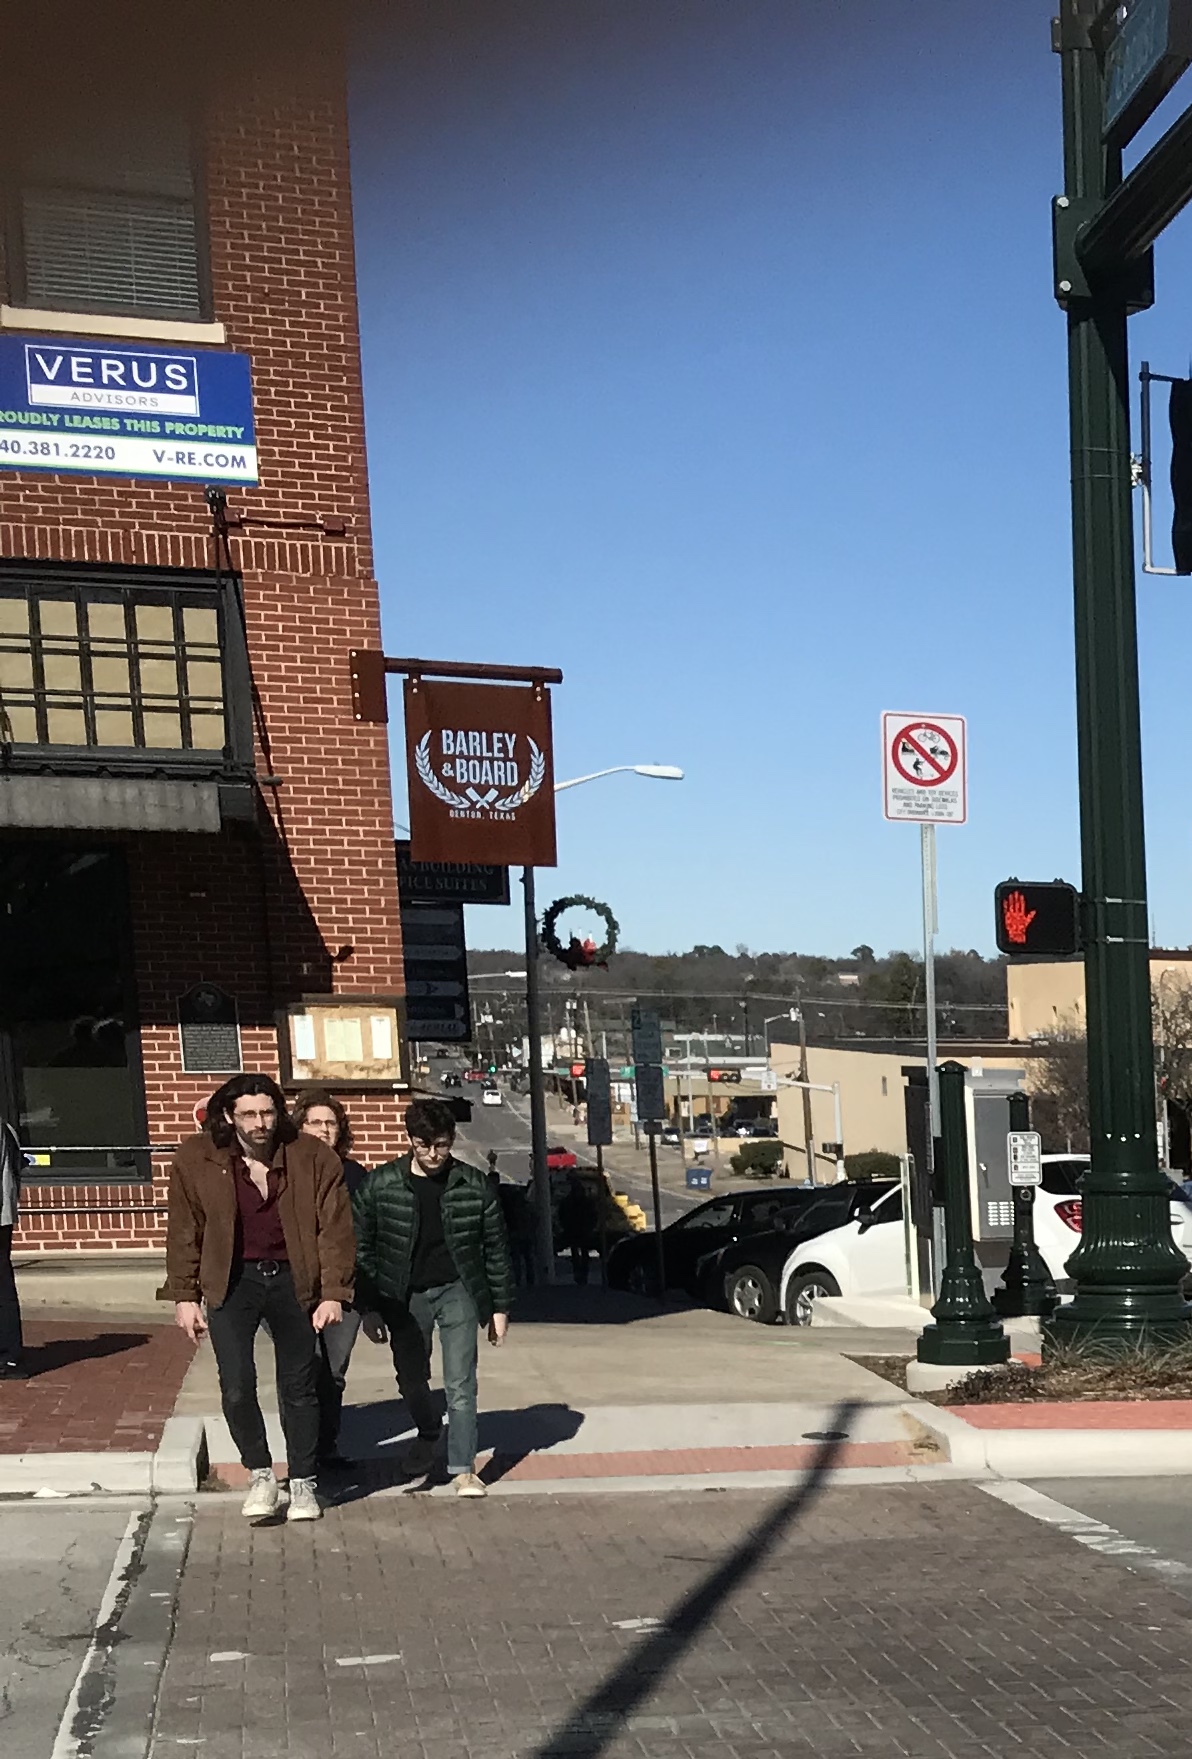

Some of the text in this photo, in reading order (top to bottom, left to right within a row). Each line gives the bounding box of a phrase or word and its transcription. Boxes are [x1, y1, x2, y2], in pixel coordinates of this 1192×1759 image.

[34, 352, 188, 391] VERUS
[70, 391, 159, 408] ADVISORS
[64, 414, 120, 430] LEASES
[124, 418, 160, 433] THIS
[164, 421, 244, 439] PROPERTY
[152, 449, 247, 469] V-RE.COM
[441, 729, 516, 758] BARLEY
